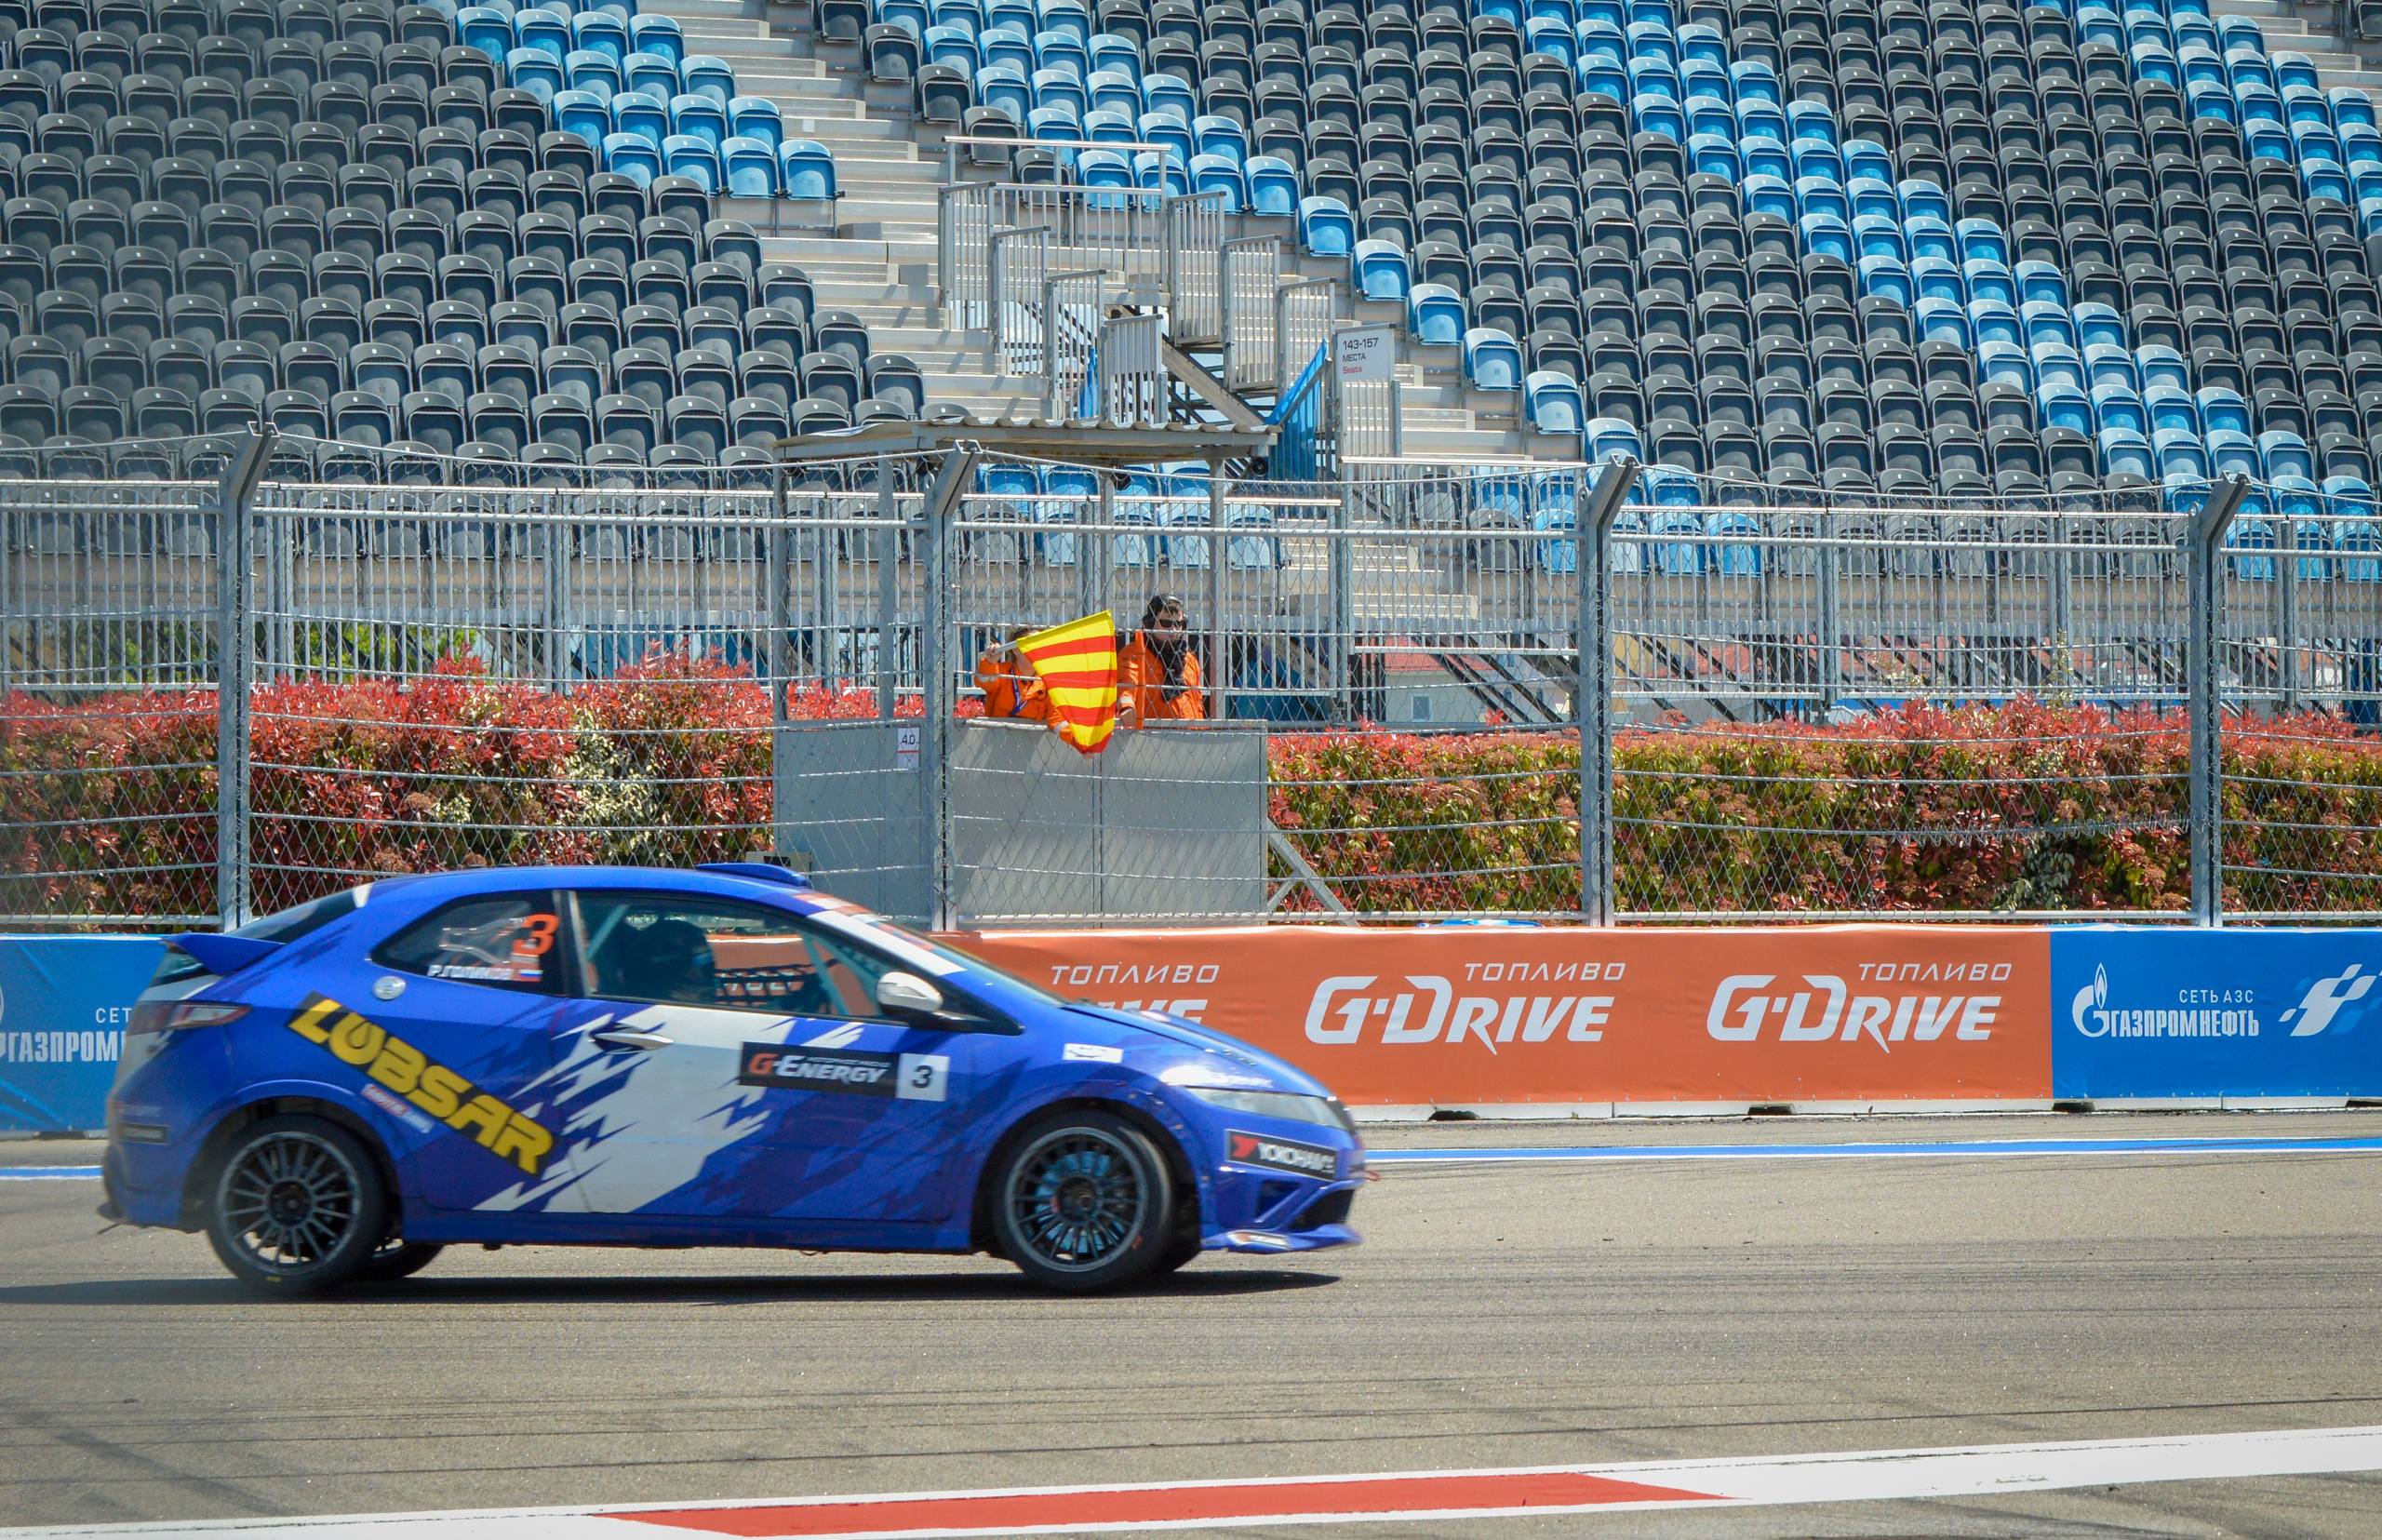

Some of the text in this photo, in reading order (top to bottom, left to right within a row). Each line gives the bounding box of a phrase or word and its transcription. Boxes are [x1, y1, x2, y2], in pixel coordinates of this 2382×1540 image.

[1343, 338, 1379, 351] 143-157
[1342, 353, 1367, 362] МЕСТА
[1343, 366, 1363, 374] Seats
[512, 913, 559, 956] 3
[1051, 964, 1220, 984] ТОПЛИВО
[1465, 962, 1626, 982] ТОПЛИВО
[1858, 962, 2013, 982] ТОПЛИВО
[2179, 989, 2255, 1004] СЕТЬ АЗС
[96, 1008, 132, 1024] СЕТ
[2110, 1009, 2260, 1038] ГАЗПРОМНЕФТЬ
[288, 998, 554, 1175] LUBSAR
[912, 1065, 933, 1089] 3
